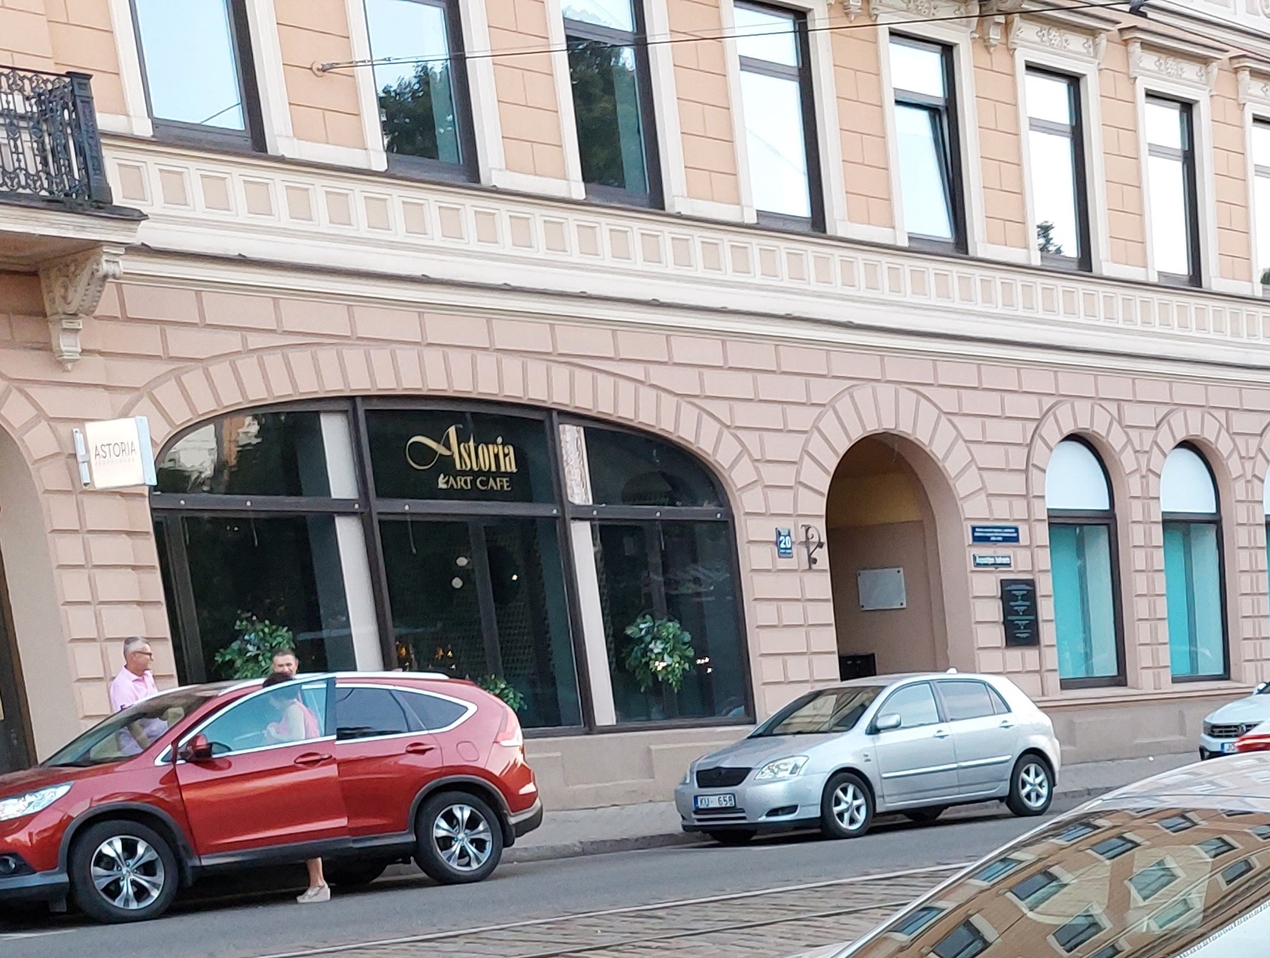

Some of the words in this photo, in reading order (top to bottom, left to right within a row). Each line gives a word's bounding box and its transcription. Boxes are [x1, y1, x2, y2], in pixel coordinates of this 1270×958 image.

[94, 441, 137, 460] ASTORIA
[406, 424, 517, 473] Astoria
[476, 476, 511, 491] CAFE
[779, 535, 792, 549] 20
